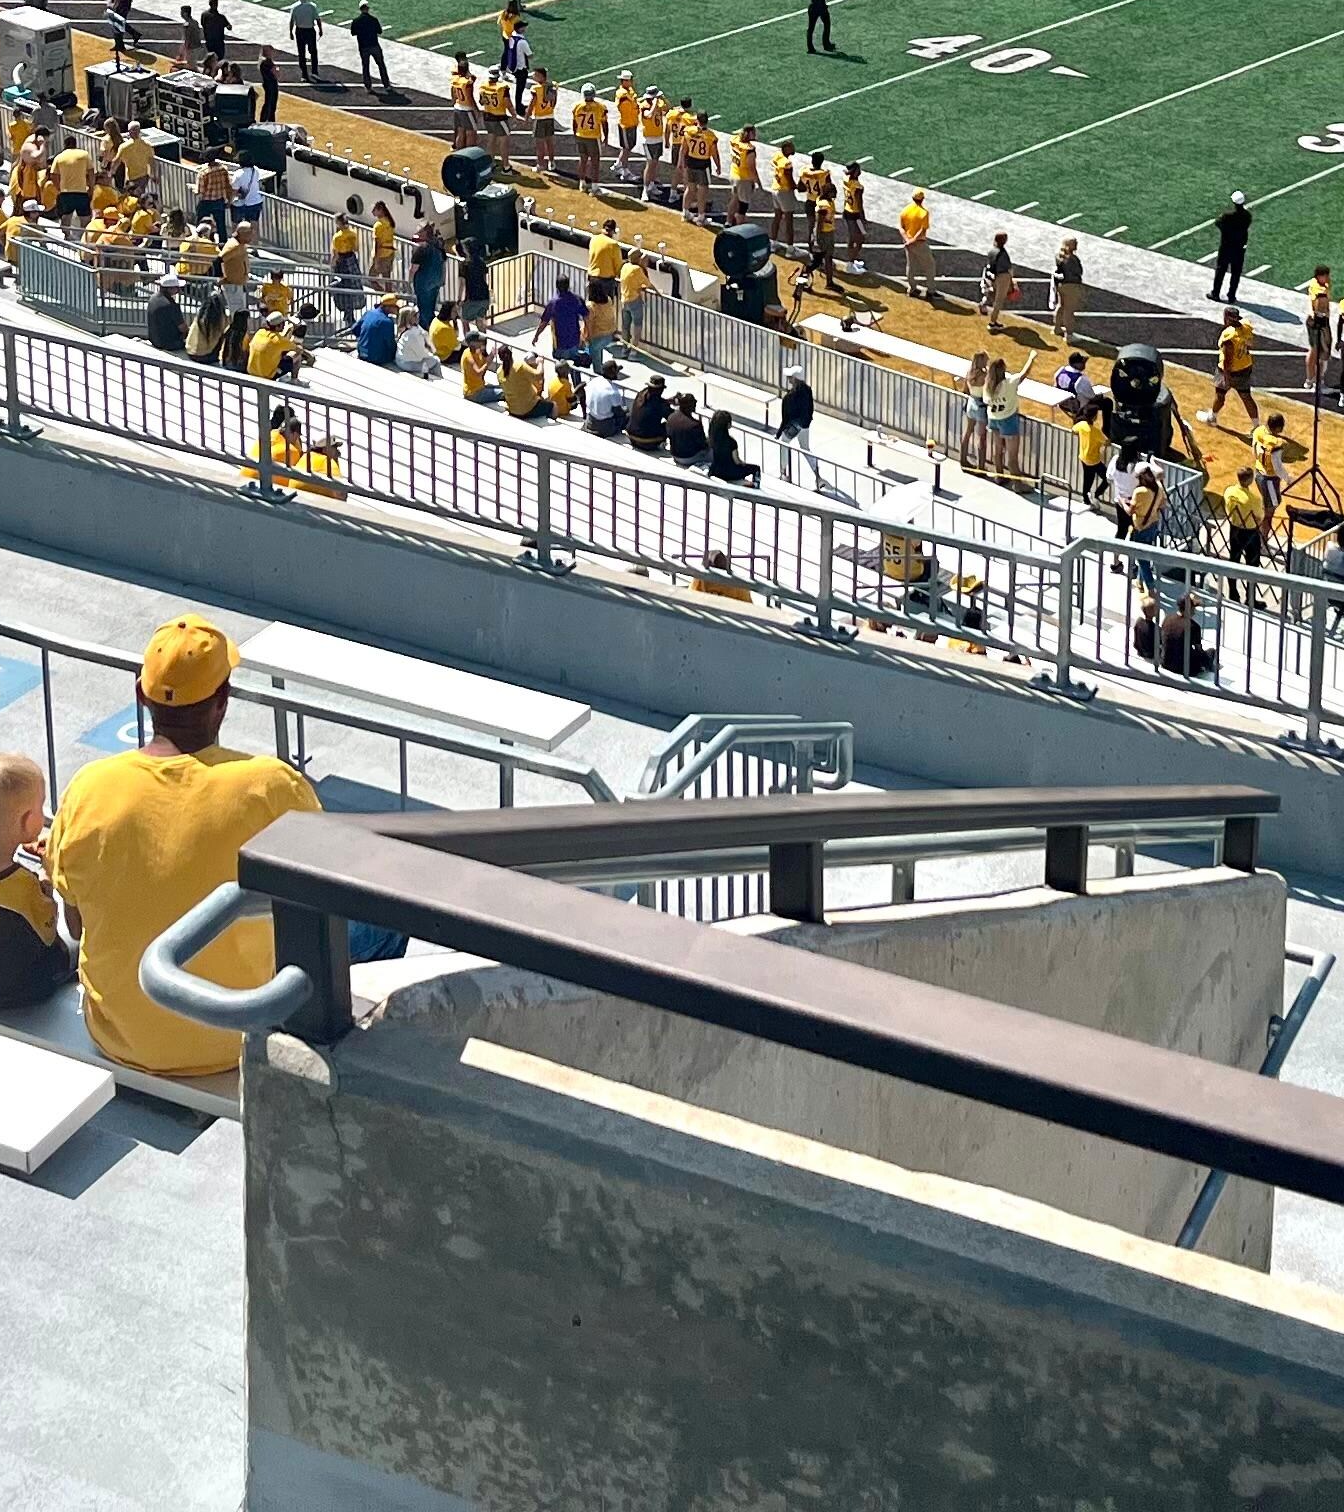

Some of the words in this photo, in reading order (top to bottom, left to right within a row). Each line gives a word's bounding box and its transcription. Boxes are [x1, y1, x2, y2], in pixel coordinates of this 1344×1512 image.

[905, 33, 1052, 75] 40
[578, 113, 595, 129] 74
[688, 139, 707, 155] 78
